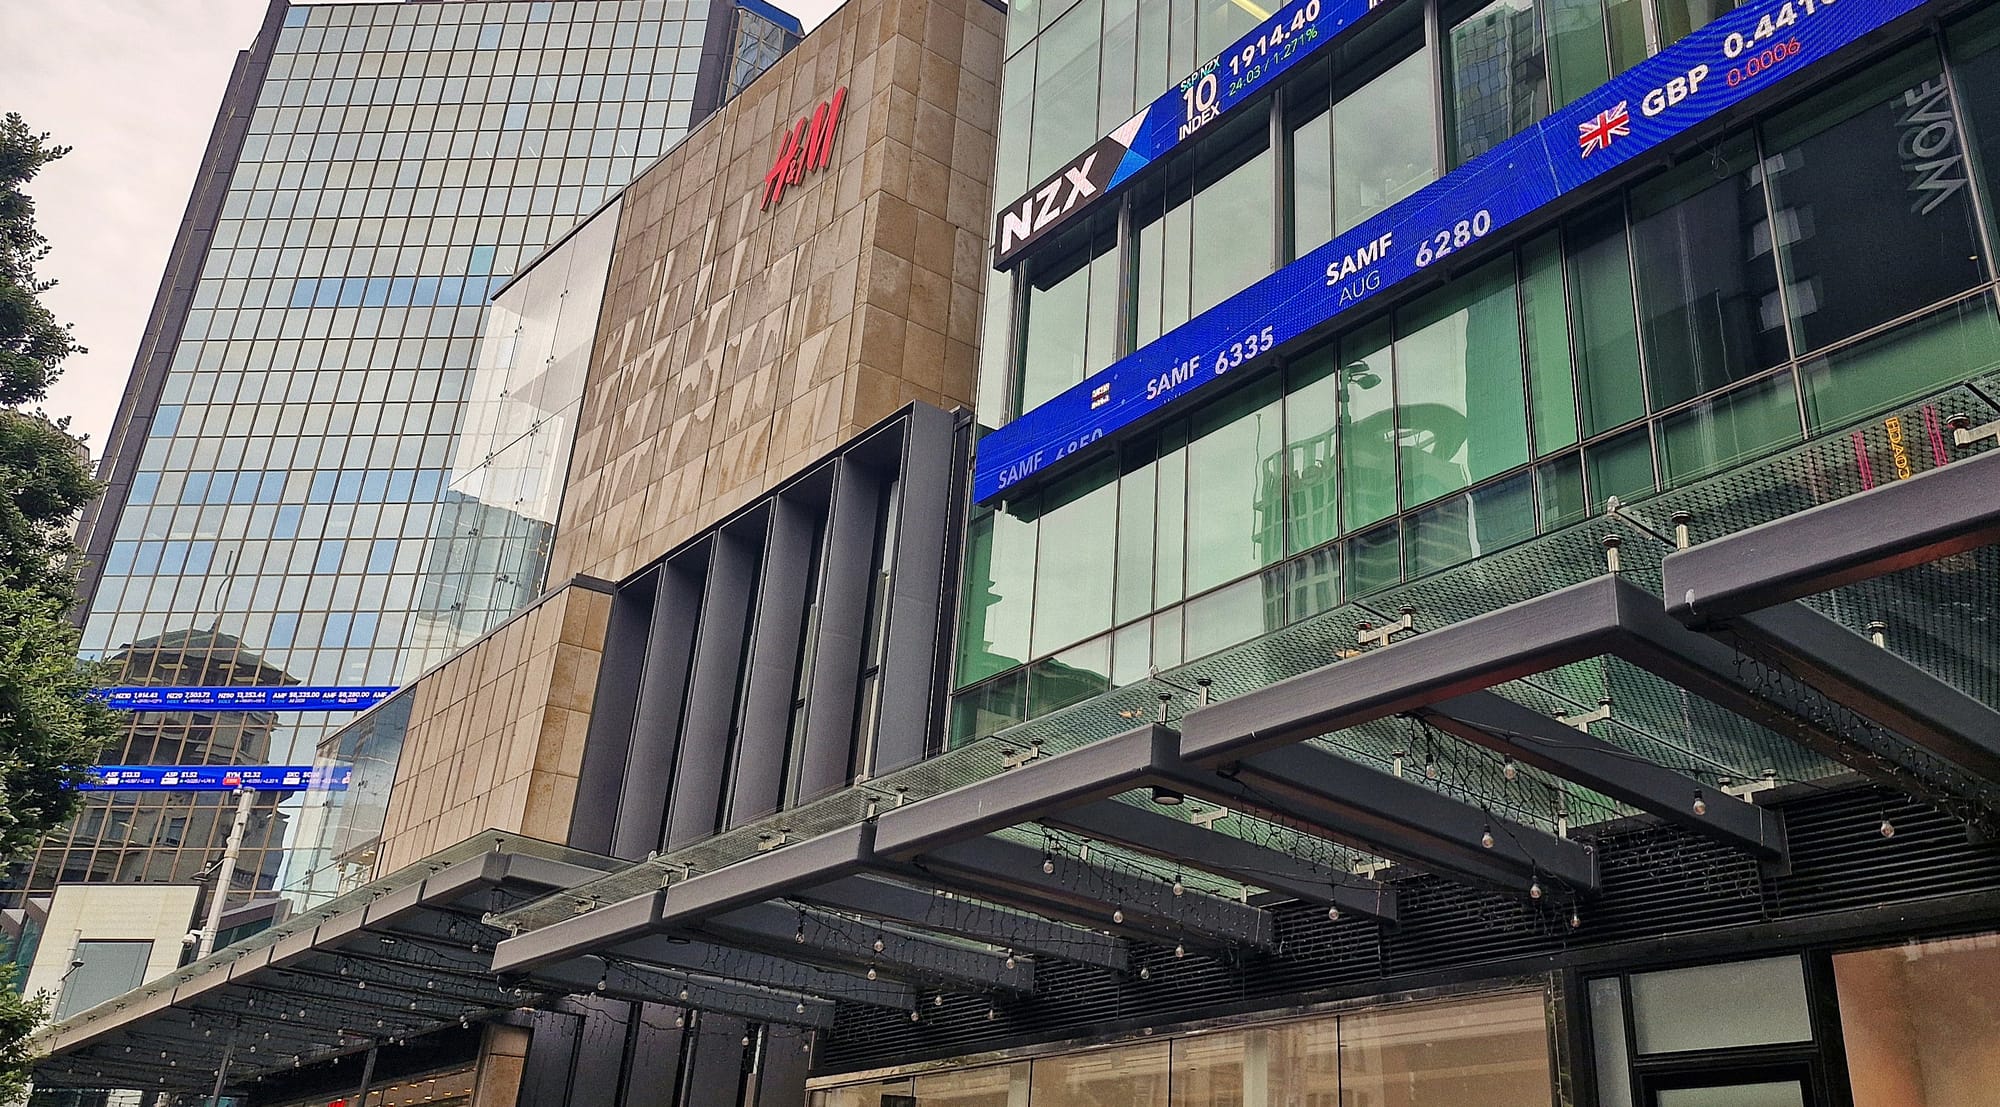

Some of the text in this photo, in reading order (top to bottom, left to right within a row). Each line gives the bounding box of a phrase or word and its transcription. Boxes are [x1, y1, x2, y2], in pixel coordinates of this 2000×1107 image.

[1229, 0, 1321, 76] 1914.40
[1229, 66, 1261, 97] 24.03
[1273, 25, 1318, 65] 1.271%
[1726, 36, 1802, 88] 0.0006
[1178, 101, 1221, 141] INDEX
[1182, 73, 1217, 121] 10
[1641, 63, 1708, 117] GBP
[760, 86, 848, 212] H&M
[1000, 150, 1099, 255] NZX
[1326, 209, 1491, 286] SAMF 6280
[1338, 270, 1381, 306] AUG
[1146, 355, 1200, 400] SAMF
[1215, 325, 1274, 375] 6335
[998, 450, 1044, 489] SAMF
